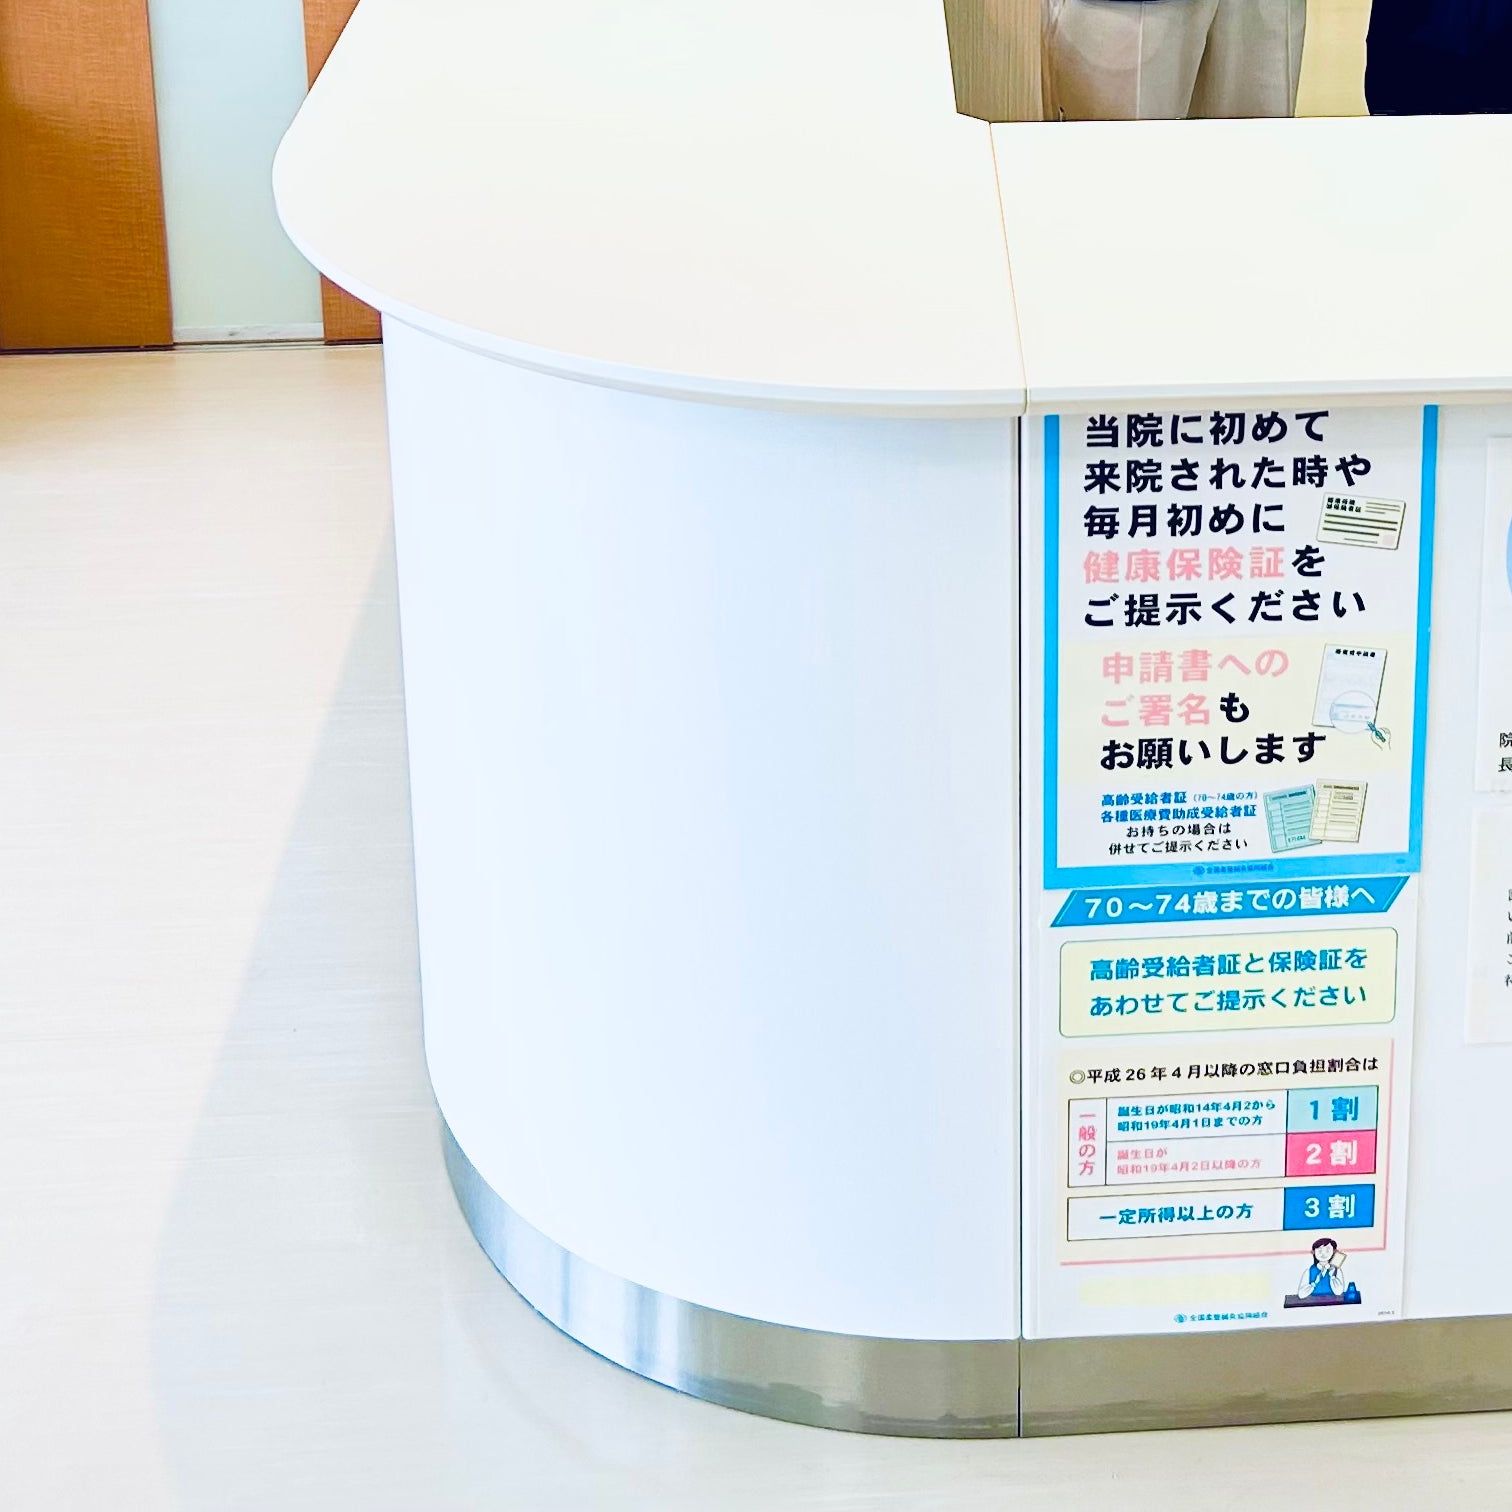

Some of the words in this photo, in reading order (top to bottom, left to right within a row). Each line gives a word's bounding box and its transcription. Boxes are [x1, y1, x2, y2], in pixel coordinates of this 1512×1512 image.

[1086, 410, 1330, 448] 当院に初めて
[1084, 454, 1372, 494] 来院された時や
[1084, 503, 1286, 539] 毎月初めに
[1083, 545, 1326, 584] 健康保険証を
[1084, 589, 1367, 628] ご提示ください
[1102, 648, 1290, 684] 申請書への
[1101, 692, 1250, 728] ご署名も
[1100, 731, 1327, 770] お願いします
[1109, 839, 1248, 855] 併せてご提示ください
[1126, 822, 1232, 838] お持ちの場合は
[1089, 948, 1368, 981] 高齢受給者証と保険証を
[1089, 985, 1367, 1017] あわせてご提示ください
[1078, 1113, 1096, 1177] 一般の方
[1099, 1203, 1254, 1226] 一定所得以上の方
